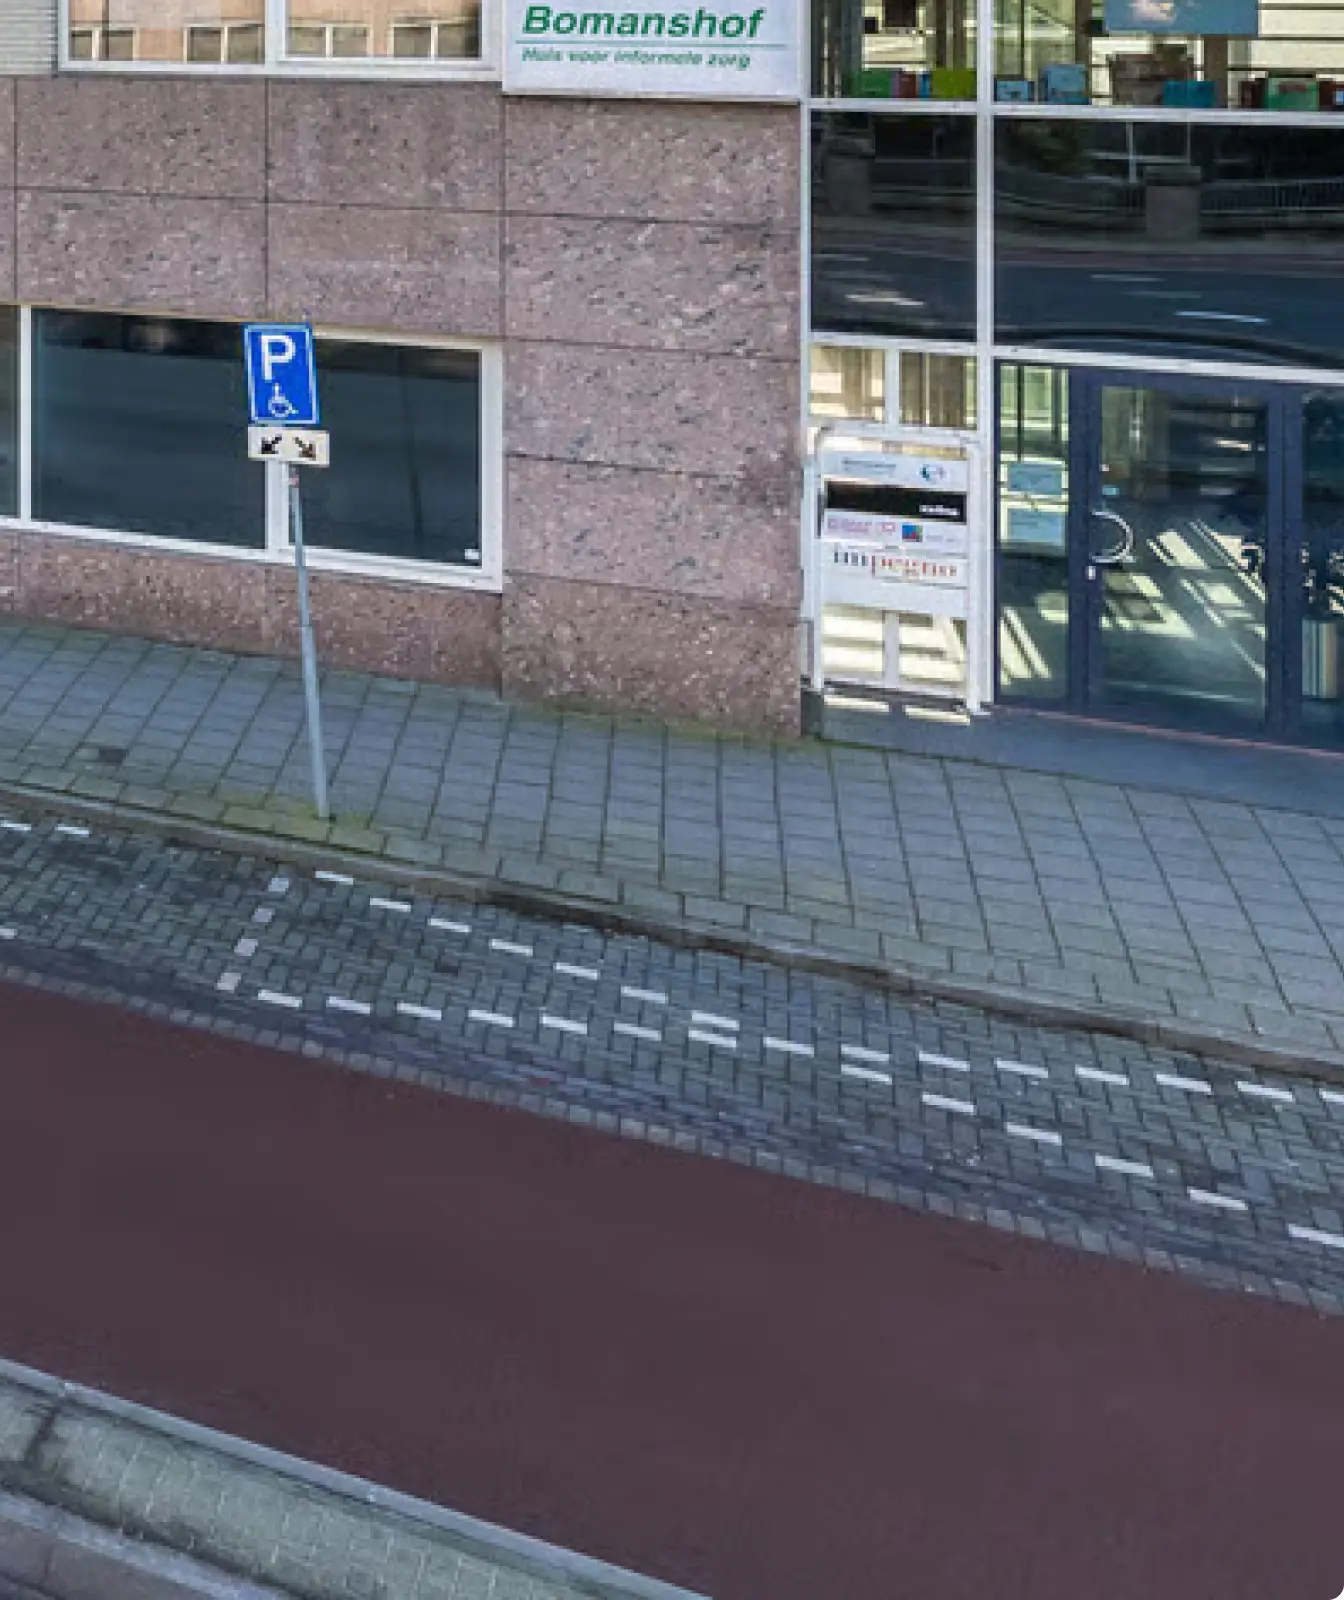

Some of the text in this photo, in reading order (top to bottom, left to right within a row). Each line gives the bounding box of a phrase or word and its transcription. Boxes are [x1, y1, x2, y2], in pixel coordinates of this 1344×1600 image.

[522, 5, 766, 38] Bomanshof
[522, 47, 750, 70] Huis voor informele zorg
[260, 334, 296, 381] P
